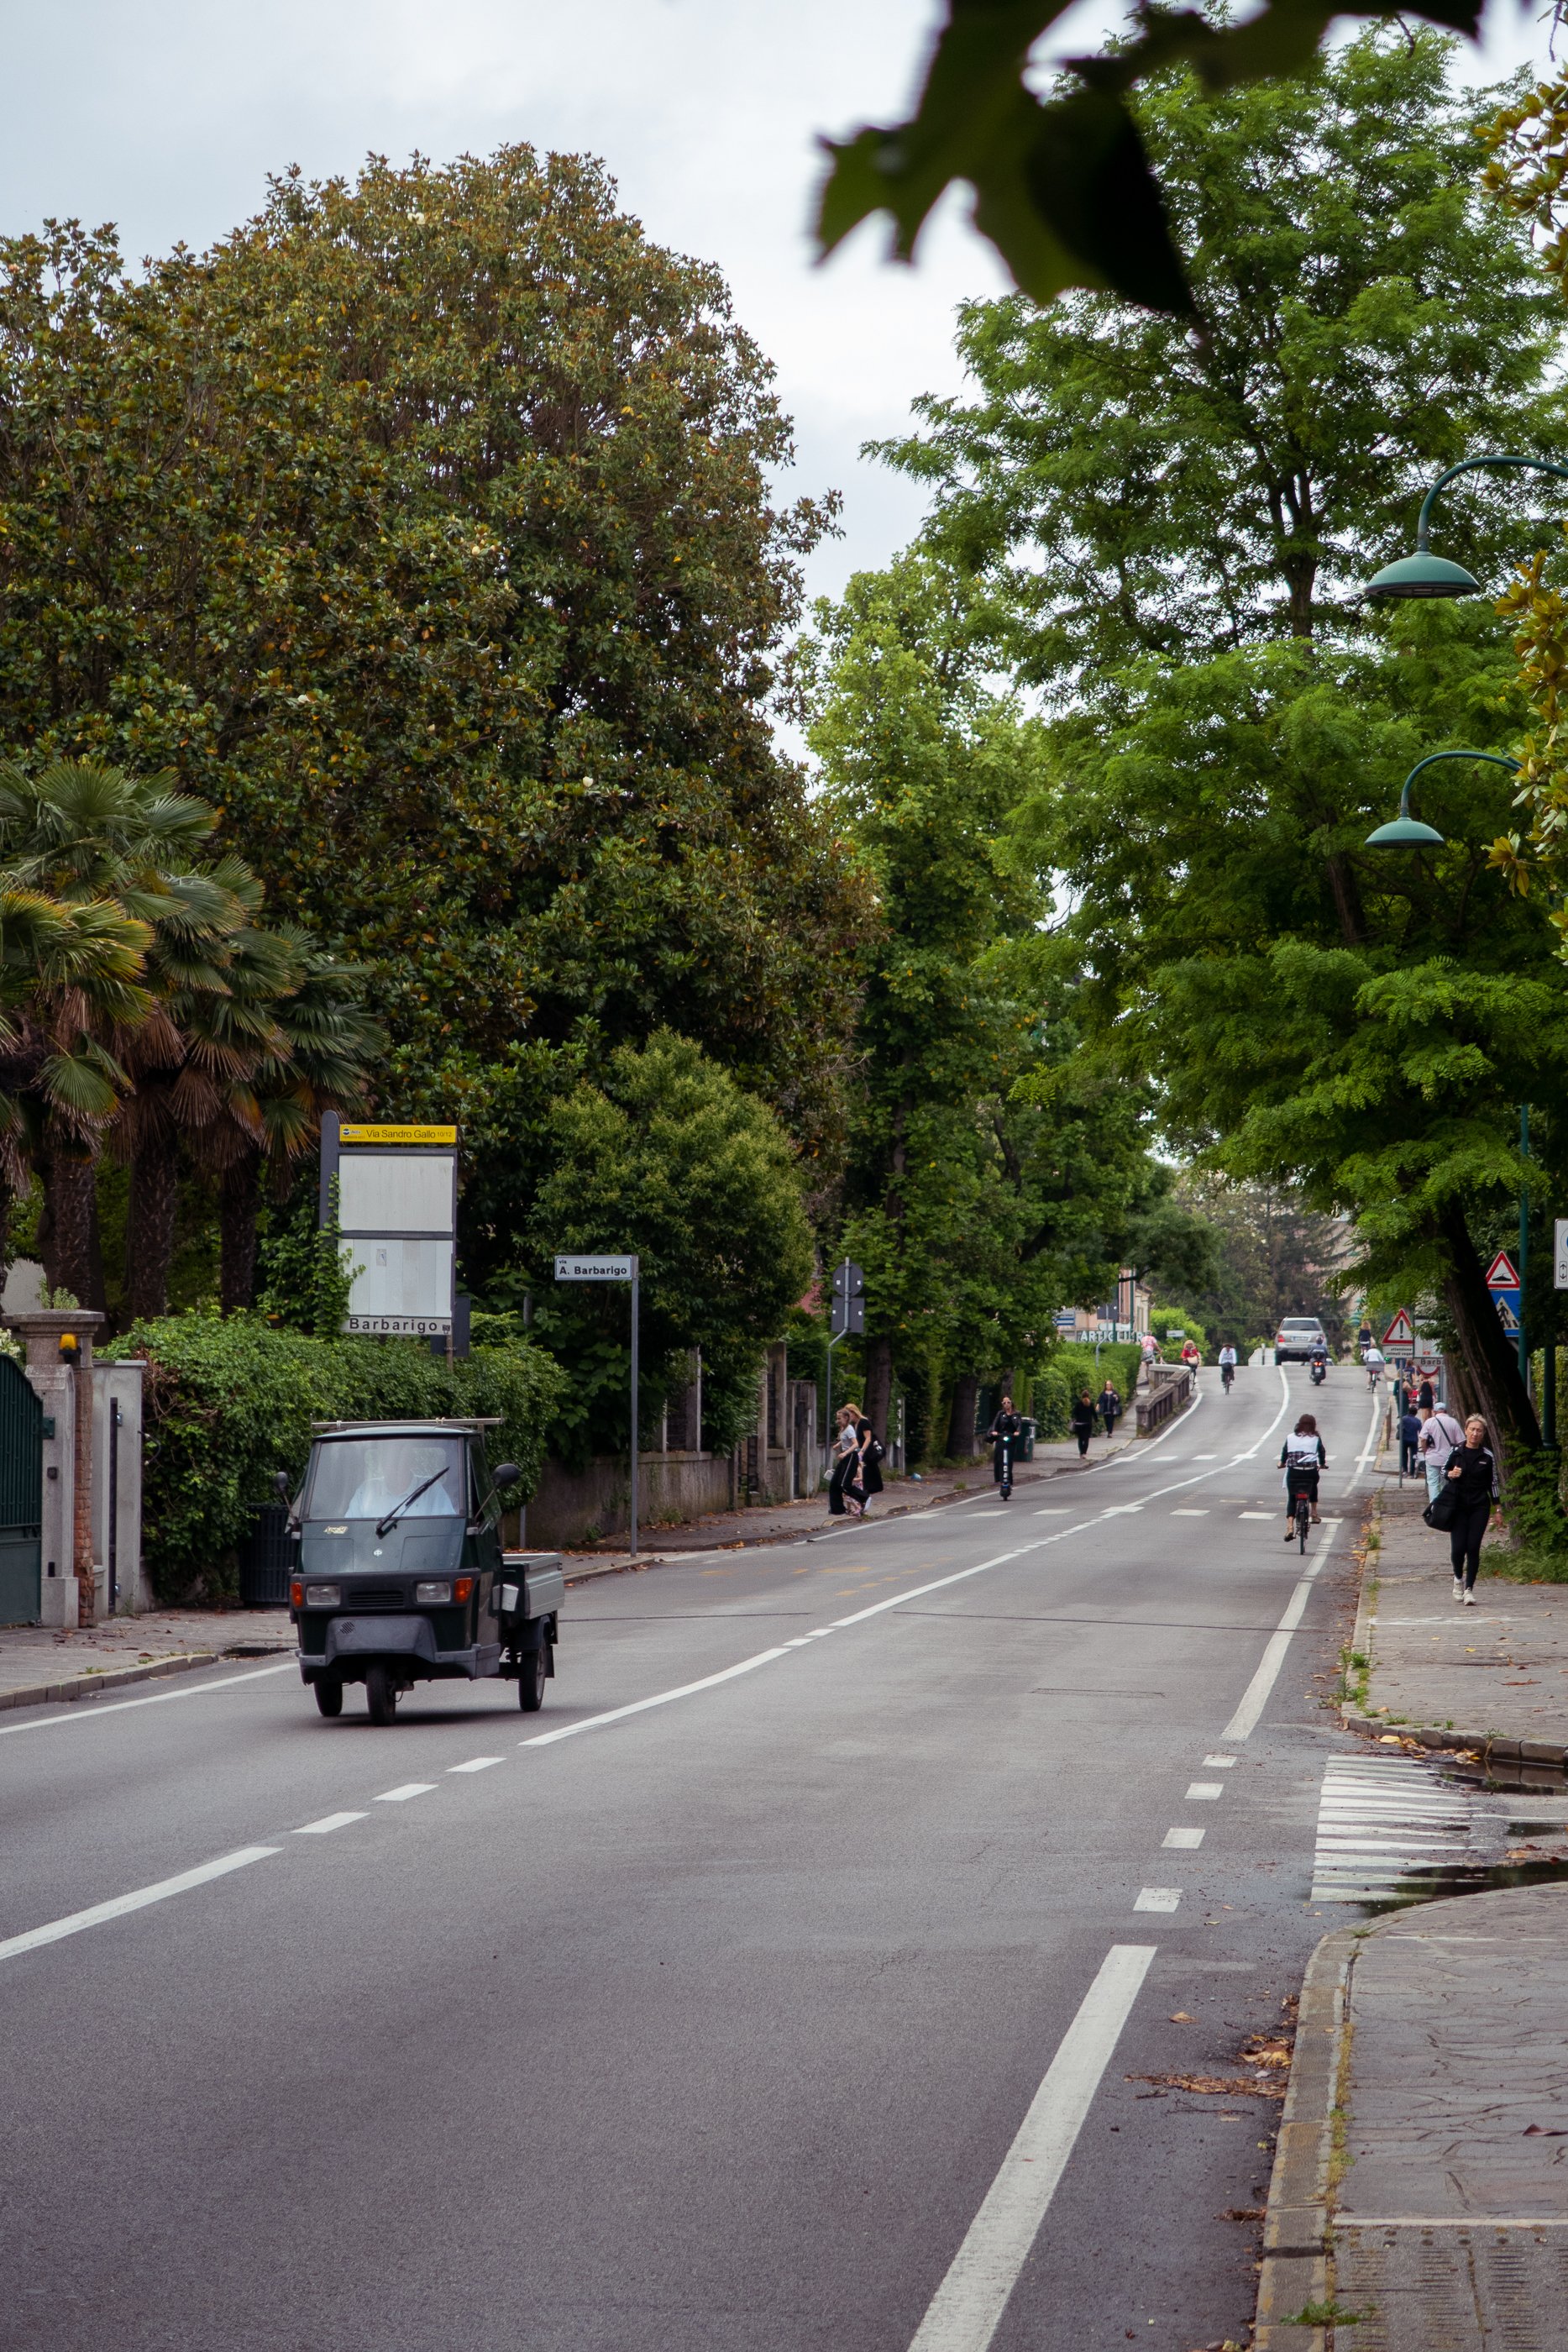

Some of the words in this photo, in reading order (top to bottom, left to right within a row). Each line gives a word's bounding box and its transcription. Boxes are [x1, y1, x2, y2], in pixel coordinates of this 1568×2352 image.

[381, 1130, 412, 1138] Sandro
[414, 1130, 436, 1138] Gallo
[559, 1266, 570, 1275] A.
[574, 1266, 627, 1276] Barbarigo
[349, 1317, 438, 1334] Barbarigo
